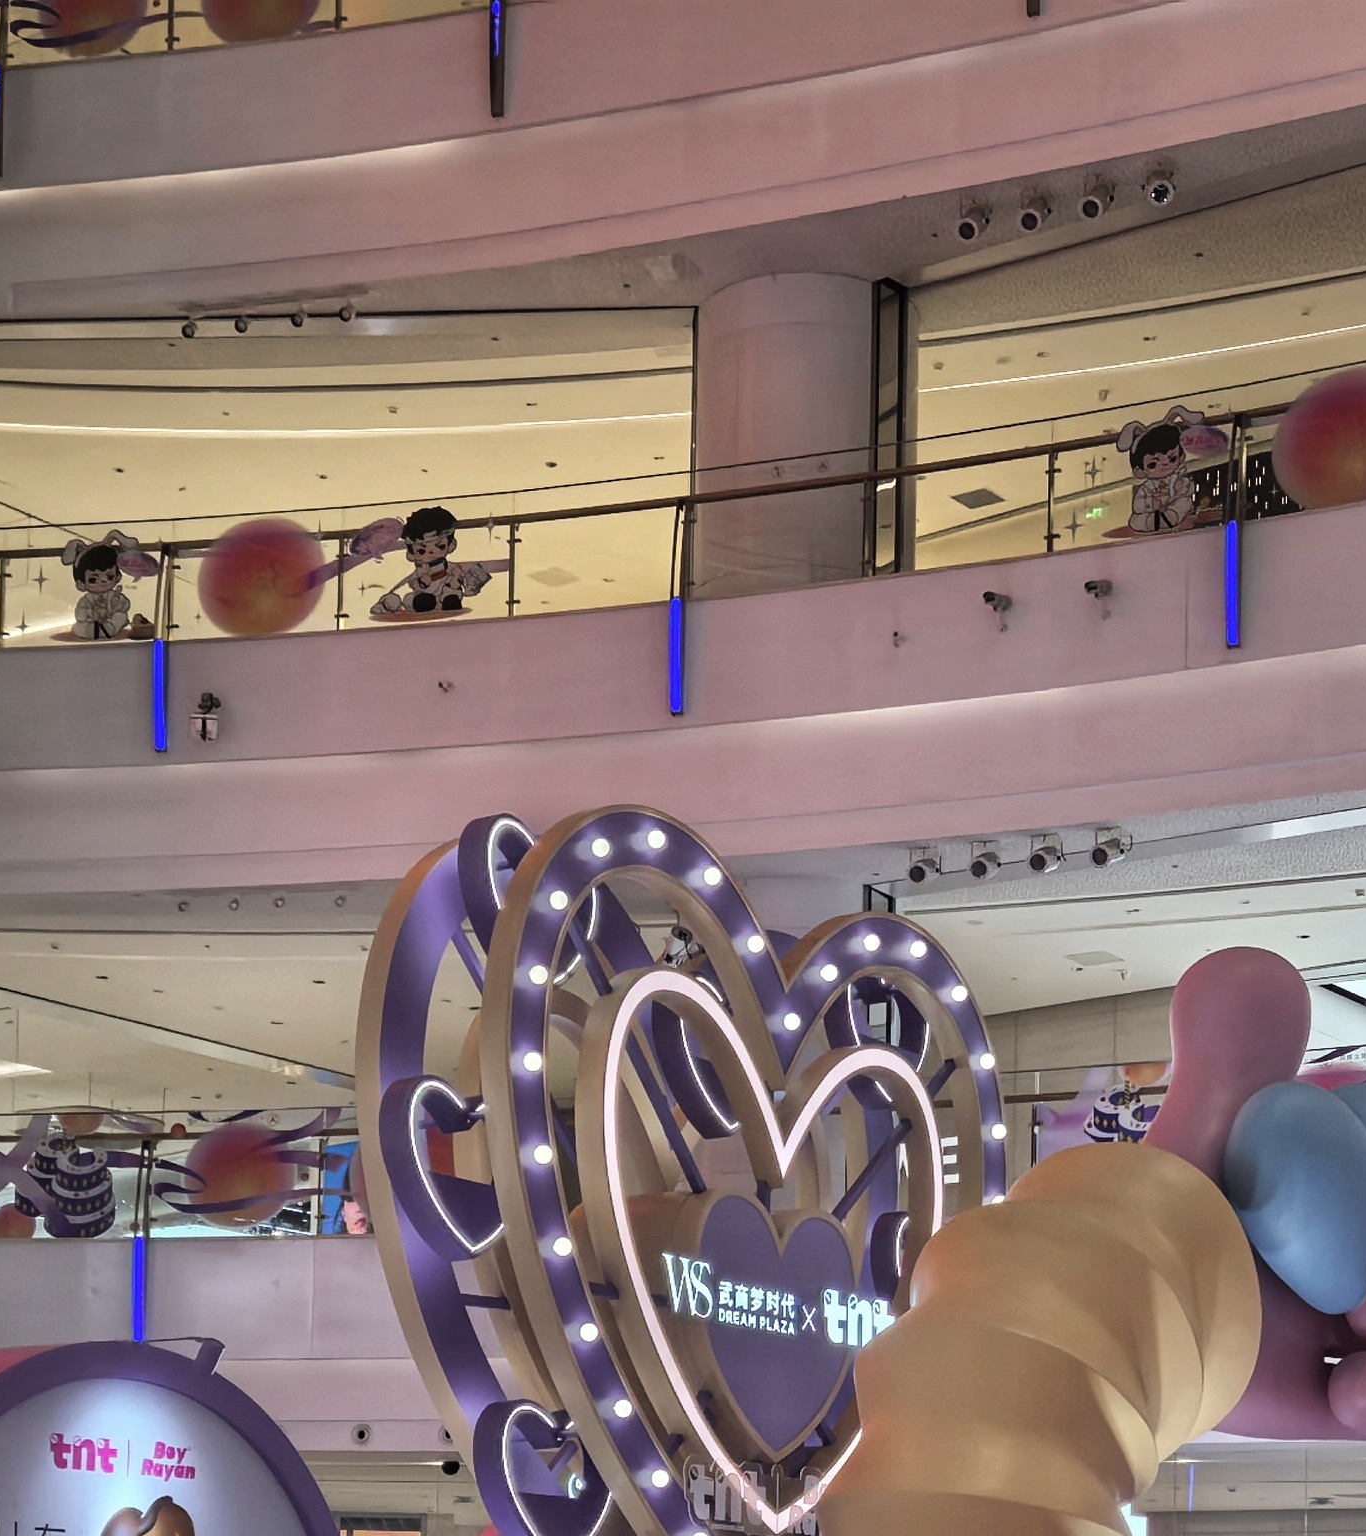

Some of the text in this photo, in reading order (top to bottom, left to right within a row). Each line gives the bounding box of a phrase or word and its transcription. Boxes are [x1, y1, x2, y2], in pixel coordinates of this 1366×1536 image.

[718, 1281, 795, 1319] 武商梦时代
[718, 1310, 795, 1337] DREAM PLAZA
[49, 1433, 118, 1474] tnt
[153, 1441, 188, 1465] Boy
[140, 1458, 196, 1482] Rayan
